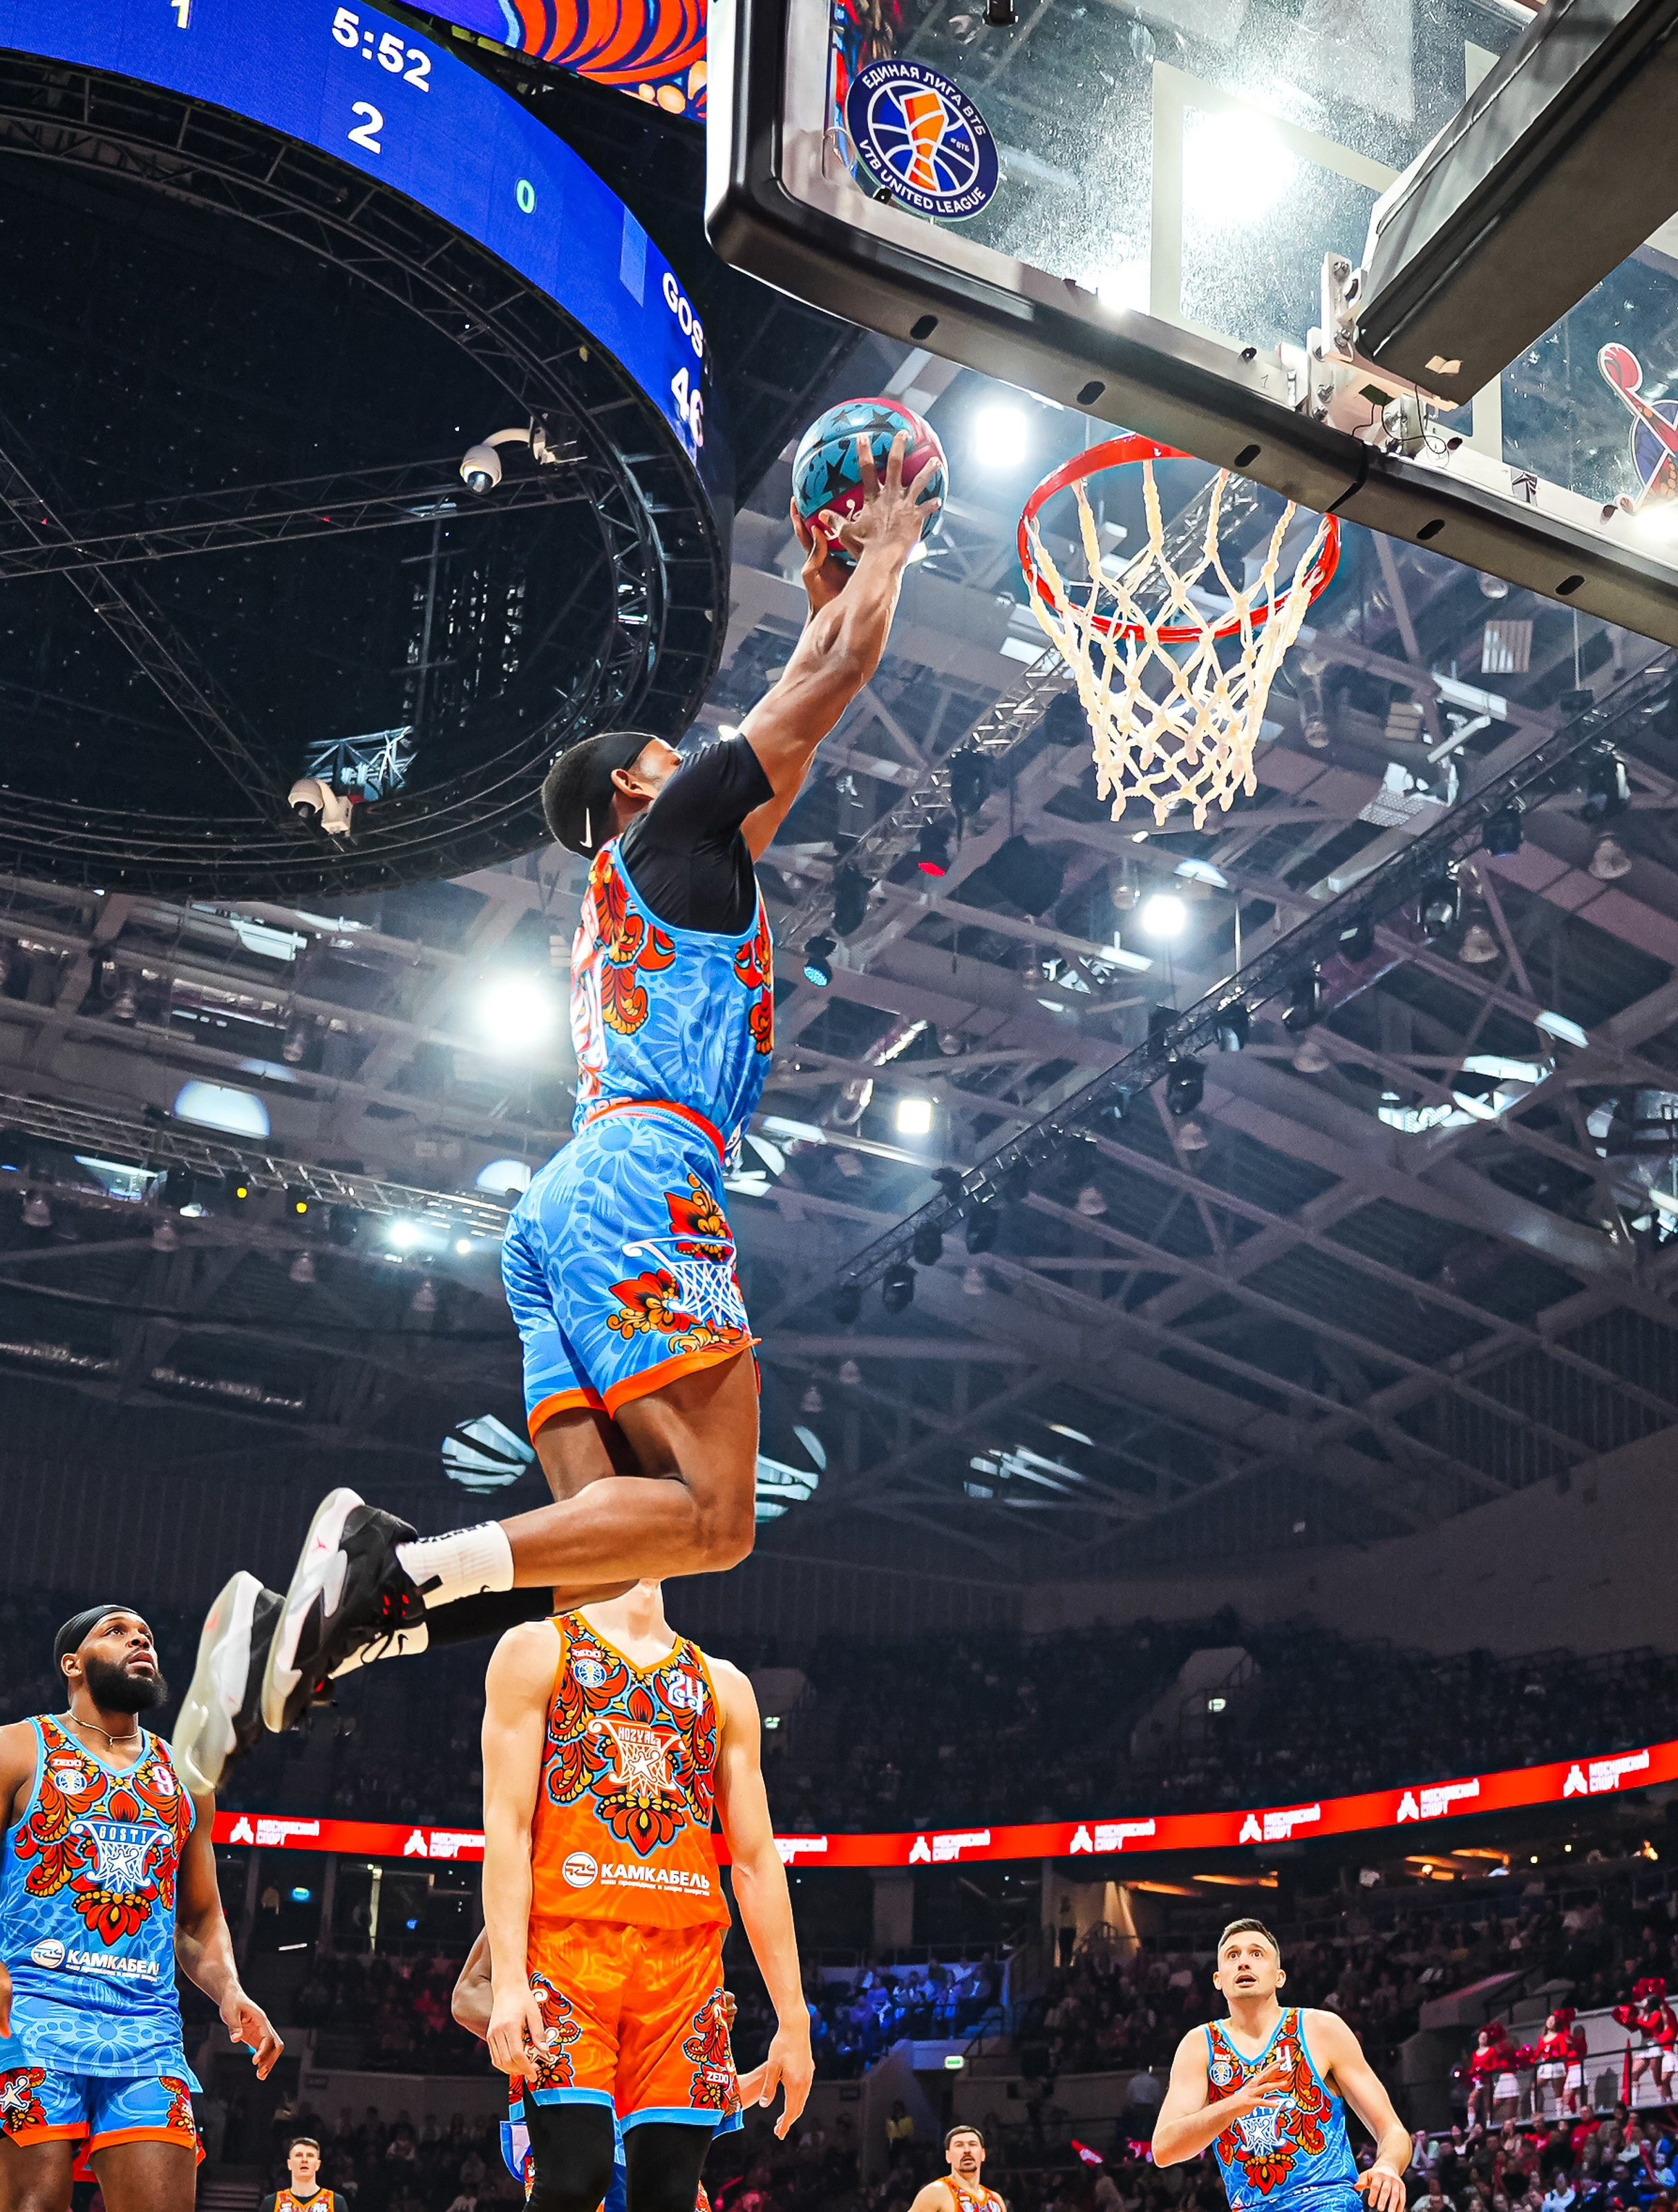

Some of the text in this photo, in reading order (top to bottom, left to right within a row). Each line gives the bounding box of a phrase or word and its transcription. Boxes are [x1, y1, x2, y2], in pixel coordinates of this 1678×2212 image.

[332, 6, 432, 93] 5:52
[862, 64, 986, 136] ЕДИНАЯ ЛИГА ВТБ
[348, 101, 385, 154] 2
[516, 178, 536, 214] 0
[859, 139, 986, 214] VTB UNITED LEAGUE
[668, 1670, 704, 1716] 24
[99, 1825, 147, 1844] GOSTI
[601, 1864, 710, 1889] КАМКАБЕЛЬ
[66, 1949, 160, 1976] КАМКАБЕЛ
[706, 2070, 729, 2084] ZEDO
